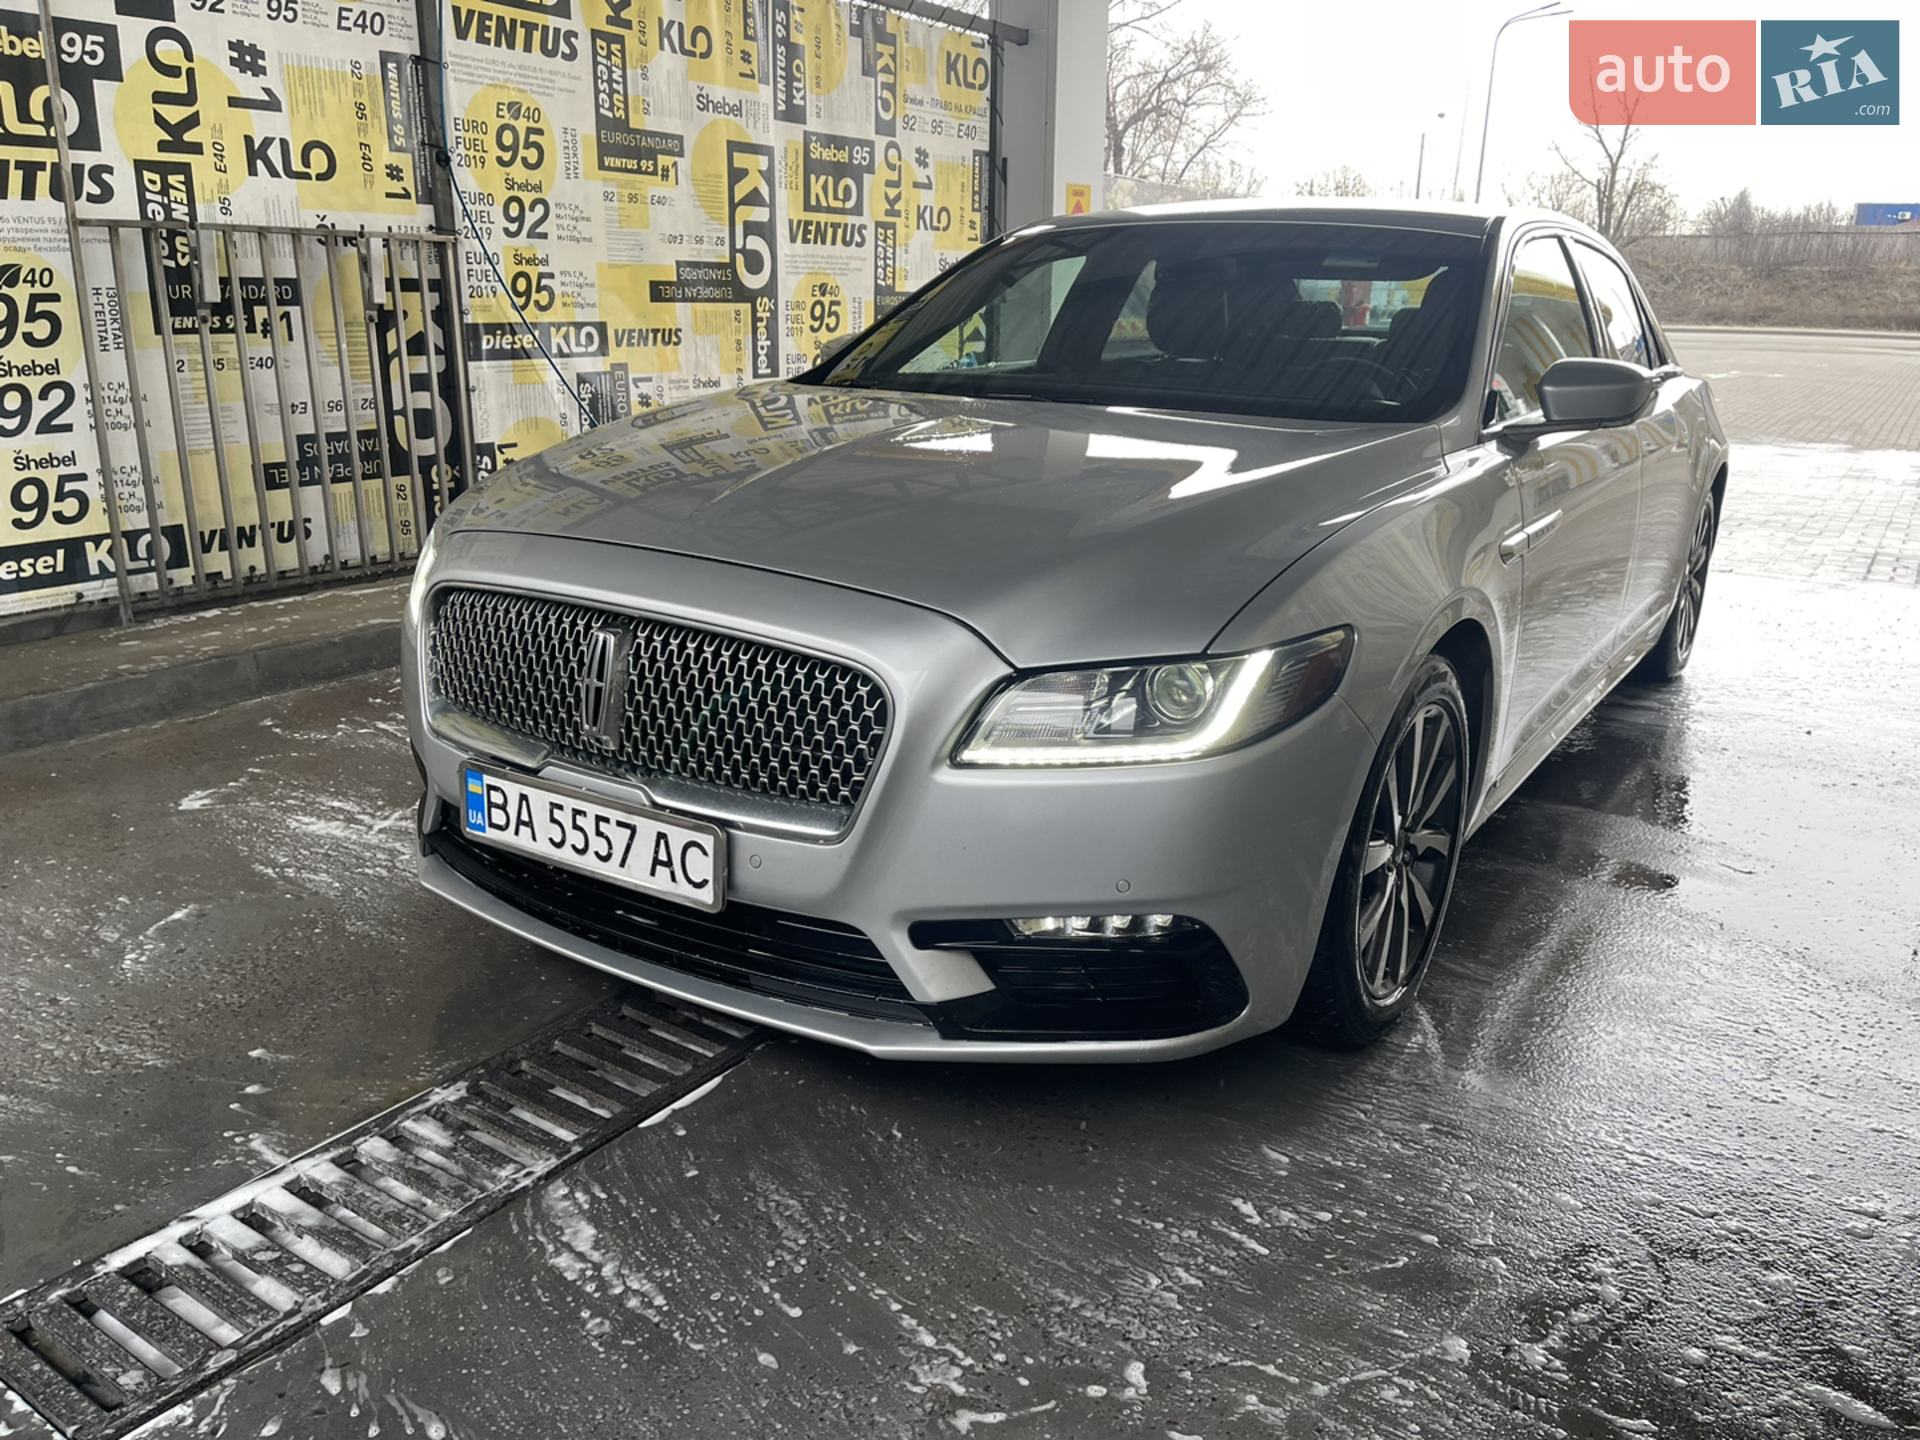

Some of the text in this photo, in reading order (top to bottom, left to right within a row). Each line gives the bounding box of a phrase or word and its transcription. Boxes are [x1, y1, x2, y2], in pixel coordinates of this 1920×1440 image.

[266, 0, 299, 24] 95
[337, 6, 385, 37] E40
[0, 25, 105, 66] bel 95
[451, 5, 579, 62] VENTUS
[638, 20, 647, 47] E40
[658, 16, 712, 60] KLO
[775, 9, 787, 111] VENTUS 95
[946, 50, 989, 91] KLO
[145, 25, 204, 156] KLO
[596, 37, 613, 119] Diesel
[611, 44, 625, 120] VENTUS
[793, 58, 805, 107] KLO
[876, 42, 895, 121] KLO
[0, 80, 81, 137] LO
[350, 59, 374, 173] 92 95 E40
[387, 62, 406, 149] VENTUS 95
[696, 85, 742, 119] Šhebel
[902, 89, 988, 118] Šhebel ПРАВО НА КРАЩЕ
[453, 116, 488, 135] EURO
[902, 113, 917, 131] 92
[930, 119, 944, 136] 95
[957, 123, 977, 140] E40
[456, 135, 489, 154] FUEL
[495, 122, 545, 171] 95
[601, 130, 680, 152] EUROSTANDARD
[810, 135, 870, 165] Šhebel 95
[211, 141, 228, 174] E40
[244, 134, 337, 181] KLO
[456, 153, 486, 169] 2019
[603, 156, 654, 171] VENTUS 95
[0, 158, 115, 204] TUS
[504, 172, 543, 193] Šhebel
[660, 160, 678, 186] #1
[884, 139, 902, 218] KLO
[461, 190, 494, 207] EURO
[603, 191, 615, 202] 92
[627, 192, 639, 204] 95
[651, 194, 667, 206] E40
[810, 173, 857, 209] KLO
[167, 173, 191, 267] VENUS
[462, 209, 496, 225] FUEL
[502, 194, 550, 240] 92
[732, 151, 772, 290] KLO
[916, 204, 951, 232] KLO
[463, 225, 493, 241] 2019
[667, 234, 725, 247] 92 95 E40
[788, 218, 868, 248] VENTUS
[465, 251, 500, 266] EURO
[513, 248, 549, 267] Šhebel
[885, 228, 894, 287] VENTUS
[467, 269, 500, 283] FUEL
[680, 267, 732, 280] STANDARDS
[468, 284, 498, 299] 2019
[510, 271, 556, 312] 95
[659, 285, 732, 299] EUROPEAN FUEL
[785, 300, 806, 311] EURO
[785, 314, 805, 325] FUEL
[809, 300, 842, 333] 95
[481, 325, 682, 354] Diesel KLO VENTUS
[756, 296, 775, 374] Šhebel
[786, 326, 803, 337] 2019
[786, 353, 807, 365] EURO
[692, 373, 721, 389] Šhebel
[0, 380, 76, 438] 92
[327, 400, 343, 413] 95
[558, 411, 568, 428] 95
[13, 449, 77, 472] Šhebel
[10, 472, 90, 530] 95
[396, 484, 412, 536] 92 95
[85, 533, 171, 576] KLO
[468, 809, 484, 826] UA
[486, 784, 710, 890] BA 5557 AC
